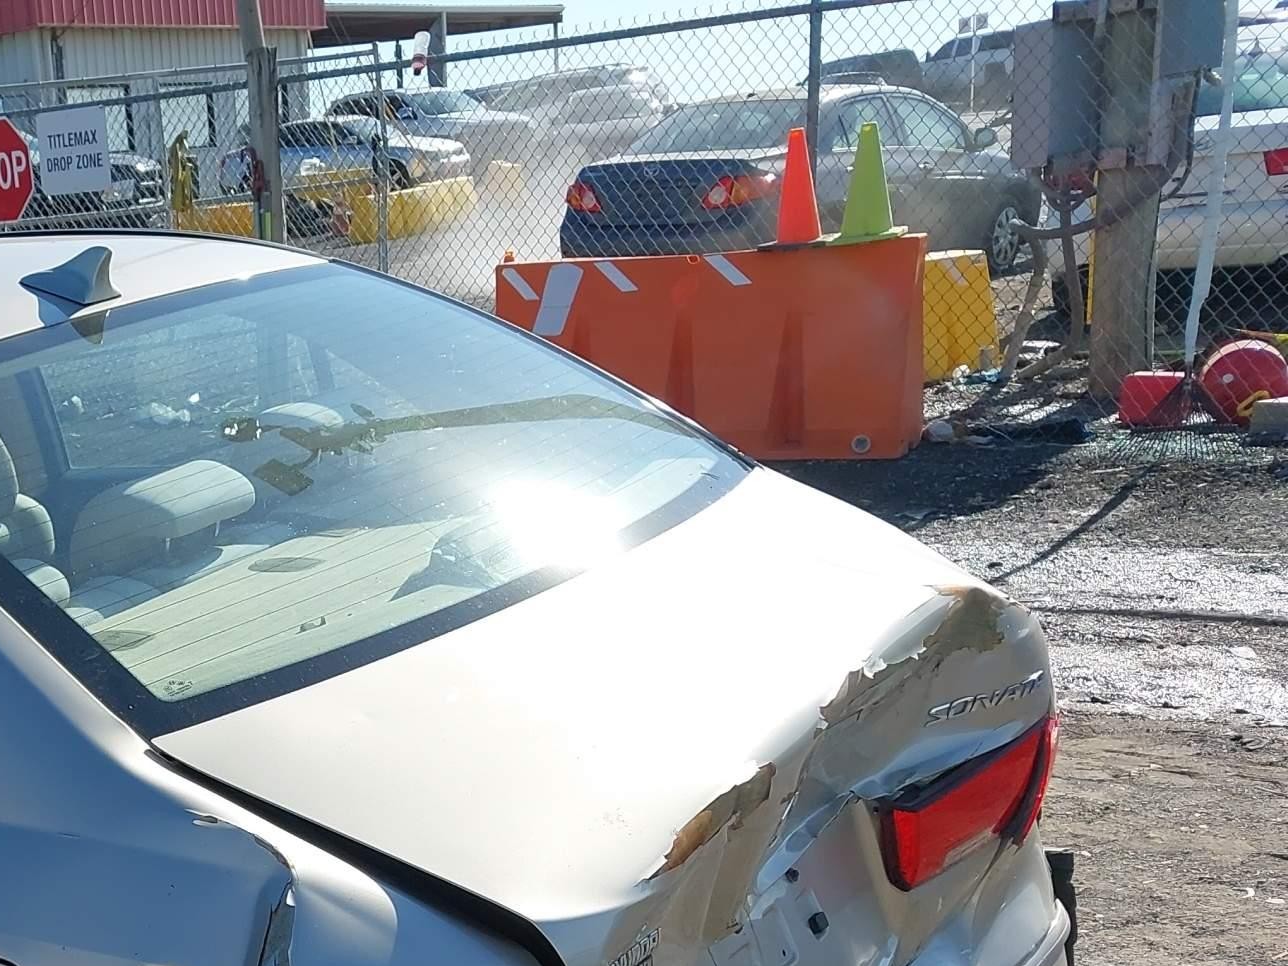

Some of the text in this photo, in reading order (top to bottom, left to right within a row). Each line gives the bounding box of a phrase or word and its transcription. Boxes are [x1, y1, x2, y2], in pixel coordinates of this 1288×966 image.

[47, 129, 98, 149] TITLEMAX
[46, 152, 103, 173] DROP ZONE
